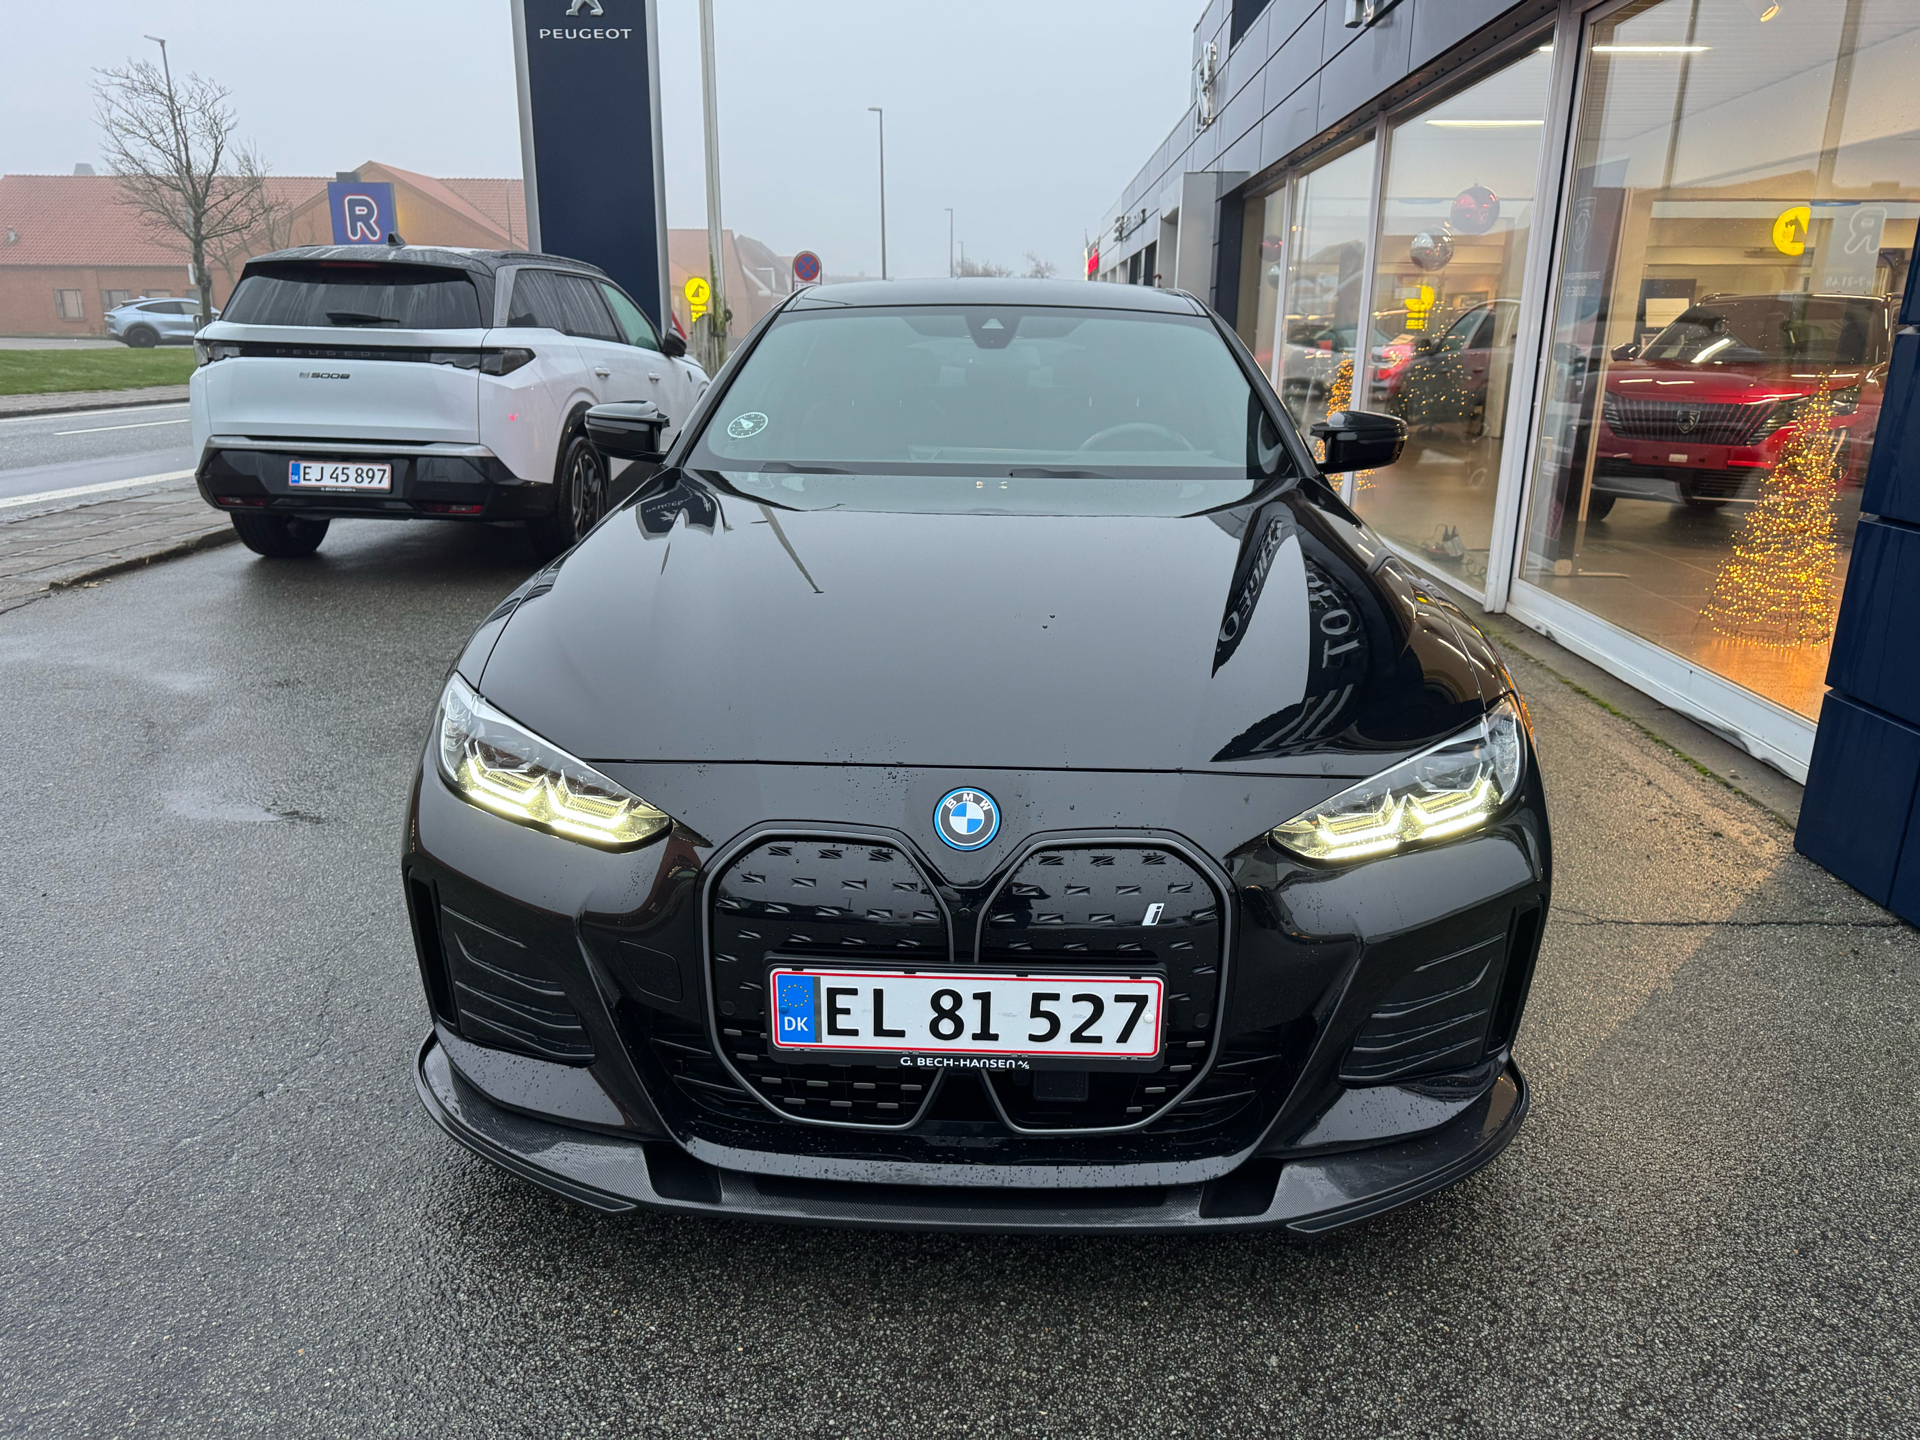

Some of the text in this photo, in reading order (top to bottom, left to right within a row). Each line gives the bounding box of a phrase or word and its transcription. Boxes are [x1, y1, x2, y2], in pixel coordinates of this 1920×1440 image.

[539, 28, 633, 40] PEUGEOT
[343, 193, 382, 242] R
[276, 348, 387, 357] PEUGEOT
[302, 465, 324, 482] EJ
[329, 466, 350, 483] 45
[354, 467, 387, 484] 897
[945, 793, 991, 811] BMW
[783, 986, 1151, 1045] DK EL 81 527
[900, 1057, 913, 1066] G.
